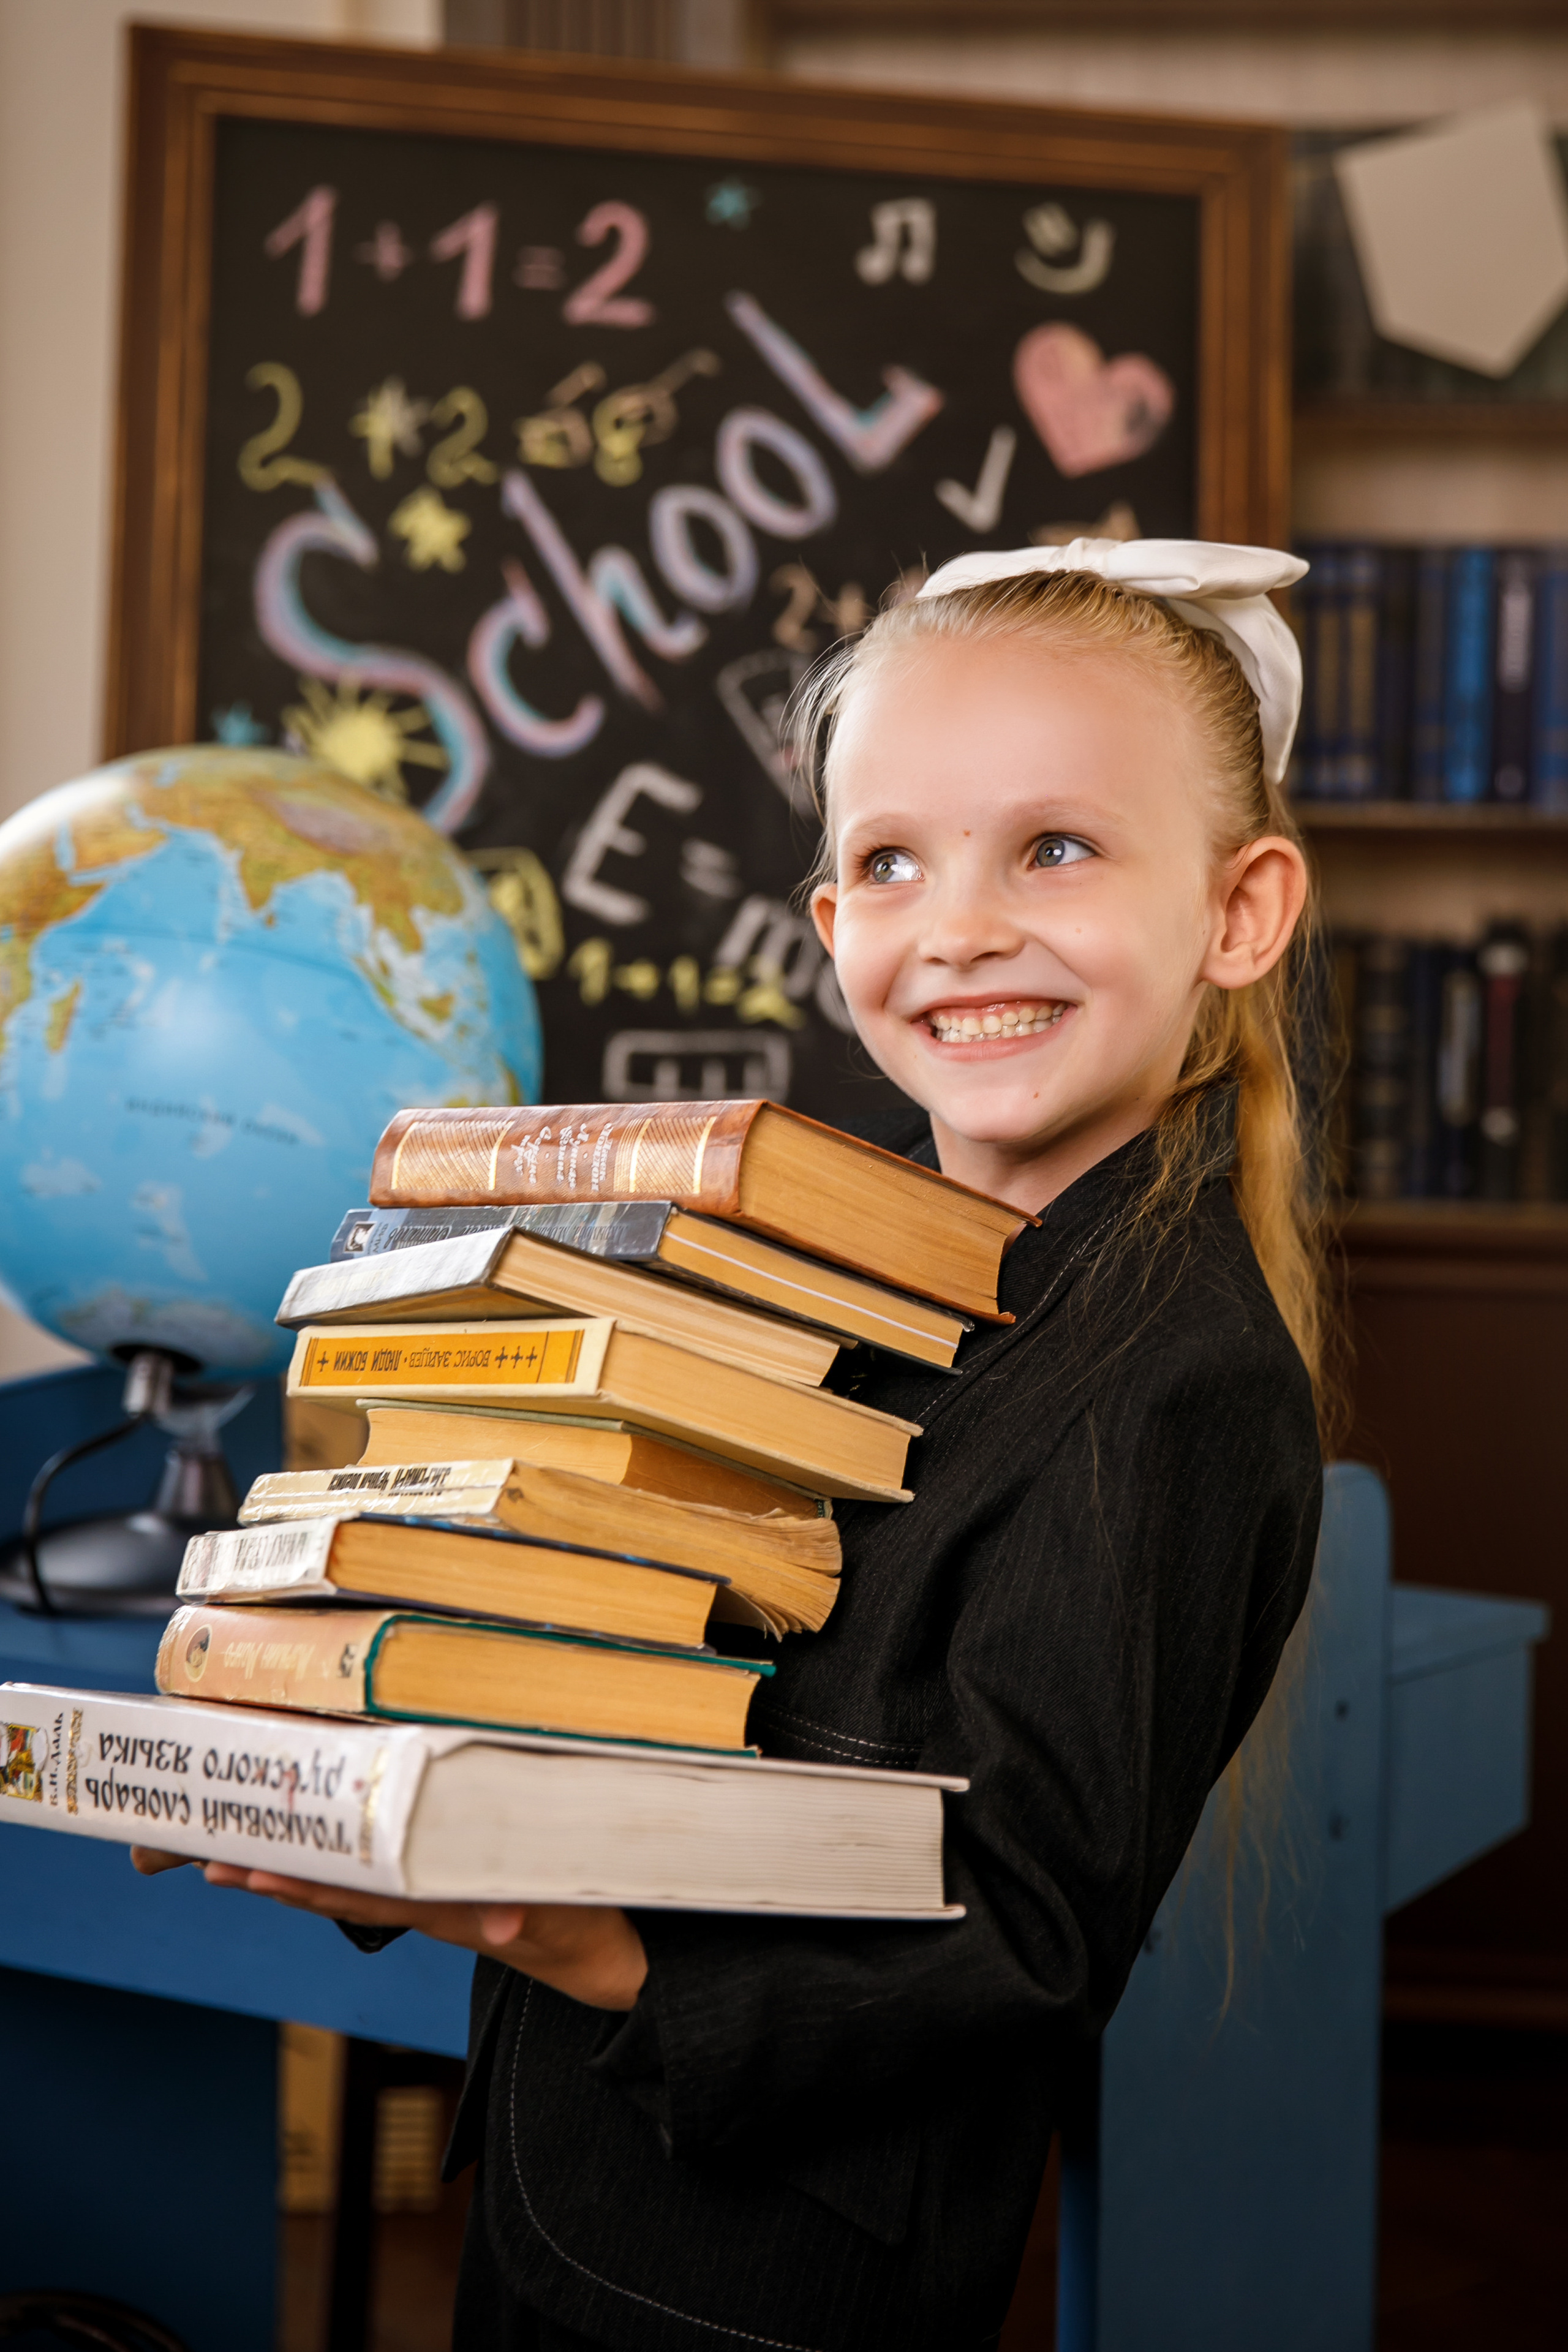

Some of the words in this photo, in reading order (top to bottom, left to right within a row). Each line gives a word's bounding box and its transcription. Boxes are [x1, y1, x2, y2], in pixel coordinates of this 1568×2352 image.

[333, 1350, 368, 1371] БОЖИИ
[371, 1349, 401, 1371] ЛЮДИ
[409, 1348, 450, 1368] ЗАЙЦЕВ
[453, 1349, 492, 1368] БОРИС
